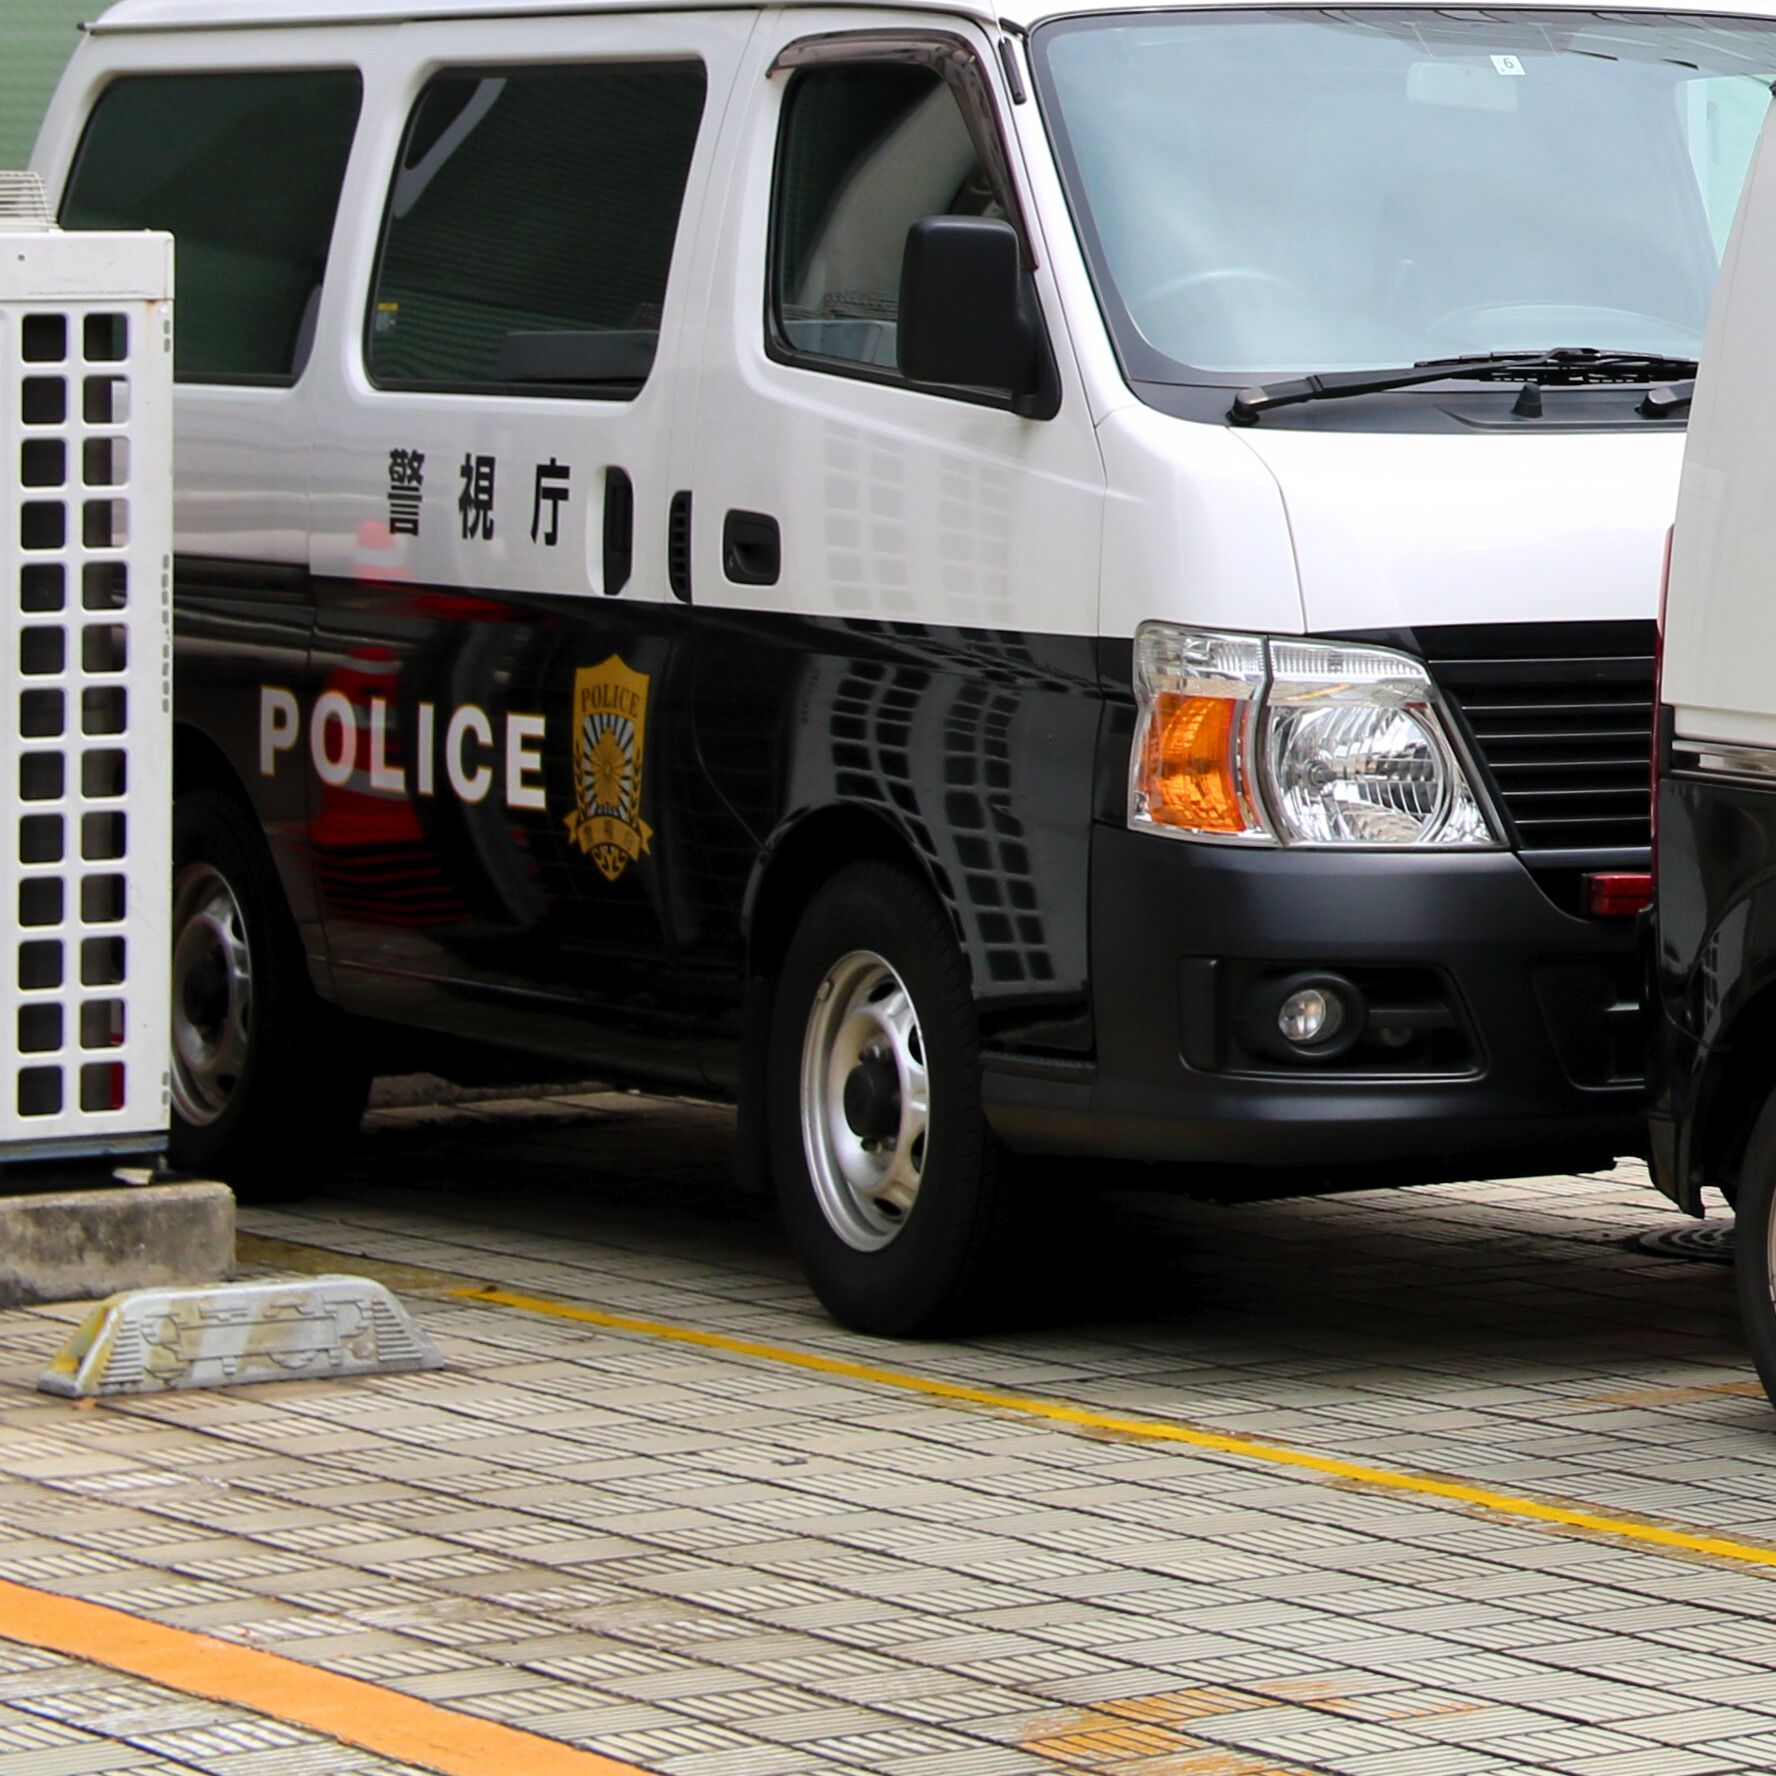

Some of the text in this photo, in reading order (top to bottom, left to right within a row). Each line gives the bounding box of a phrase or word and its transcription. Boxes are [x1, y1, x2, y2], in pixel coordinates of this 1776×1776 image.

[387, 448, 570, 546] 警視庁
[259, 684, 547, 812] POLICE
[580, 683, 640, 718] POLICE
